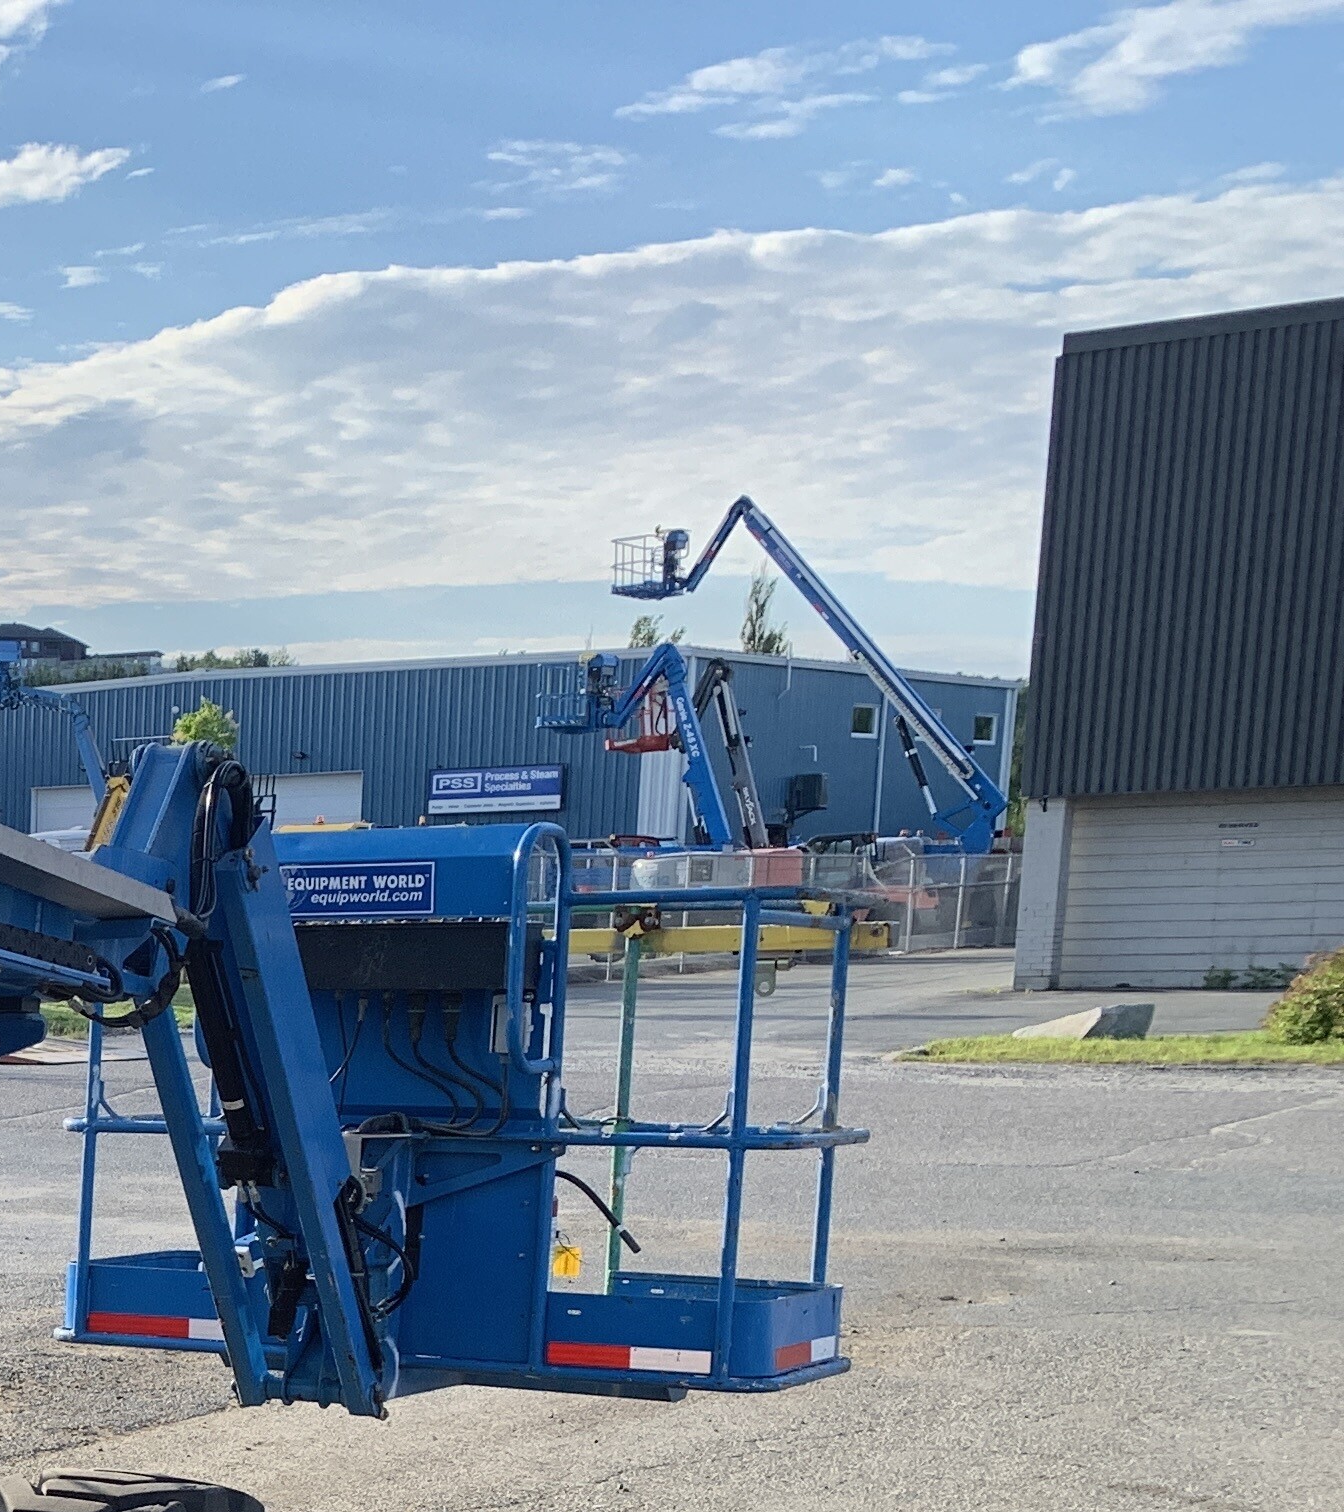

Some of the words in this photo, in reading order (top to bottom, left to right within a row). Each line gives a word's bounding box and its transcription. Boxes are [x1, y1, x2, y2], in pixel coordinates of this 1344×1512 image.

[484, 772, 520, 781] Process
[520, 770, 529, 780] &
[529, 769, 559, 780] Steam
[438, 777, 475, 790] PSS
[484, 781, 532, 793] Specialties
[287, 875, 368, 891] EQUIPMENT
[373, 873, 426, 889] WORLD
[310, 889, 423, 906] equipworld.com
